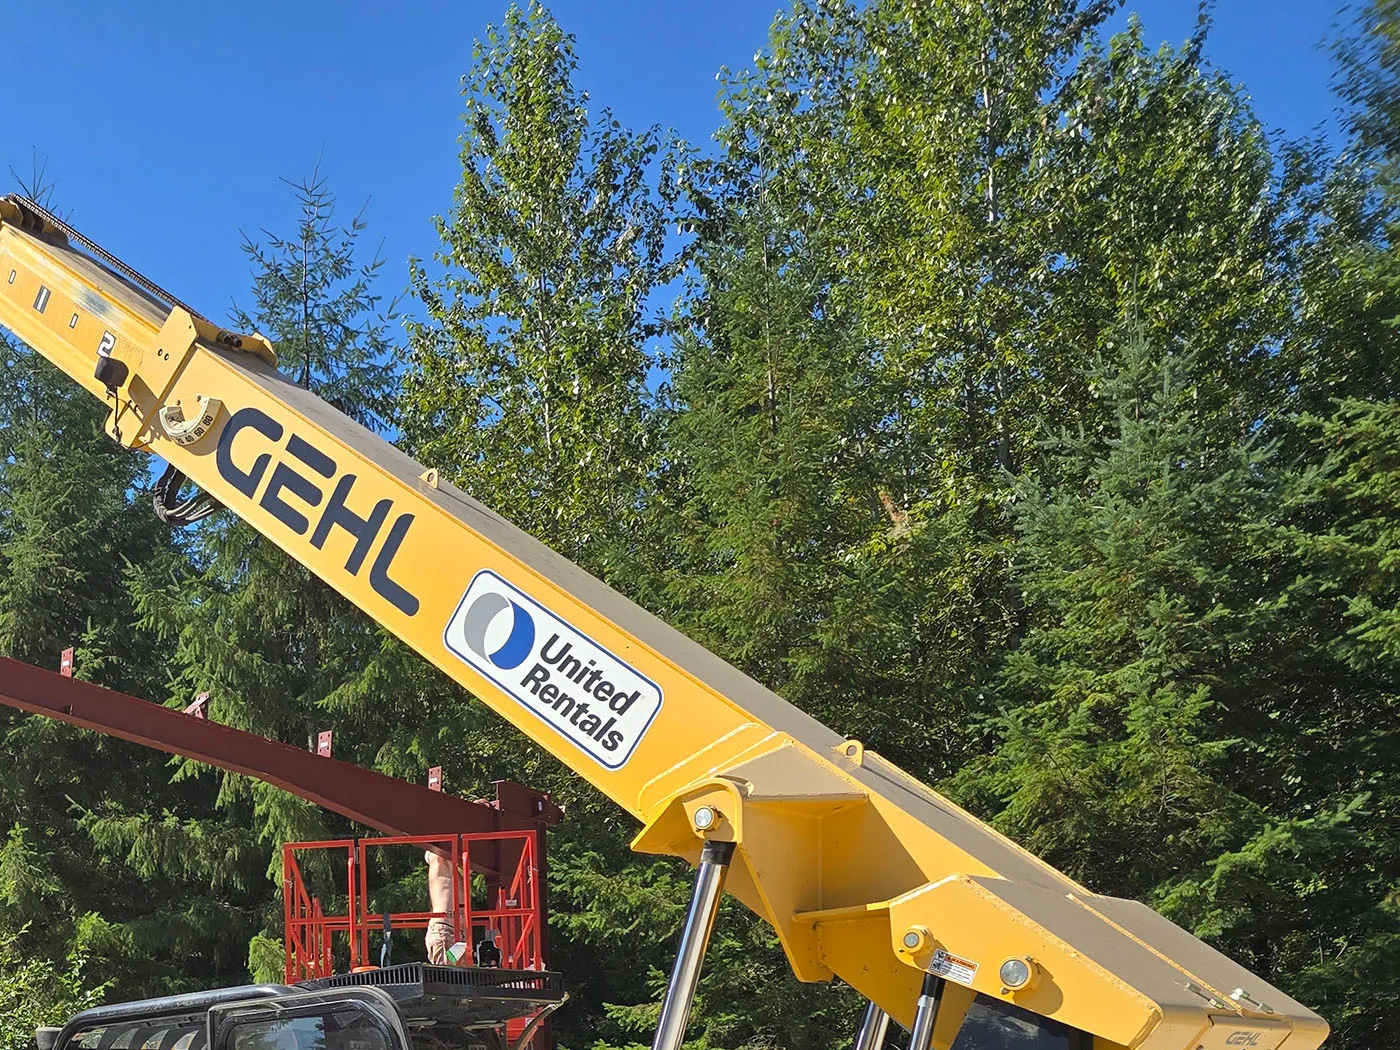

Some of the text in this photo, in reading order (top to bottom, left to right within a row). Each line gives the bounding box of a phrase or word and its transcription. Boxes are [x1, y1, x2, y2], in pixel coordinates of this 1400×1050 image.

[96, 331, 116, 358] 2
[216, 407, 420, 617] GEHL
[520, 663, 625, 755] Rentals
[540, 633, 641, 718] United
[1225, 1031, 1262, 1046] GEHL
